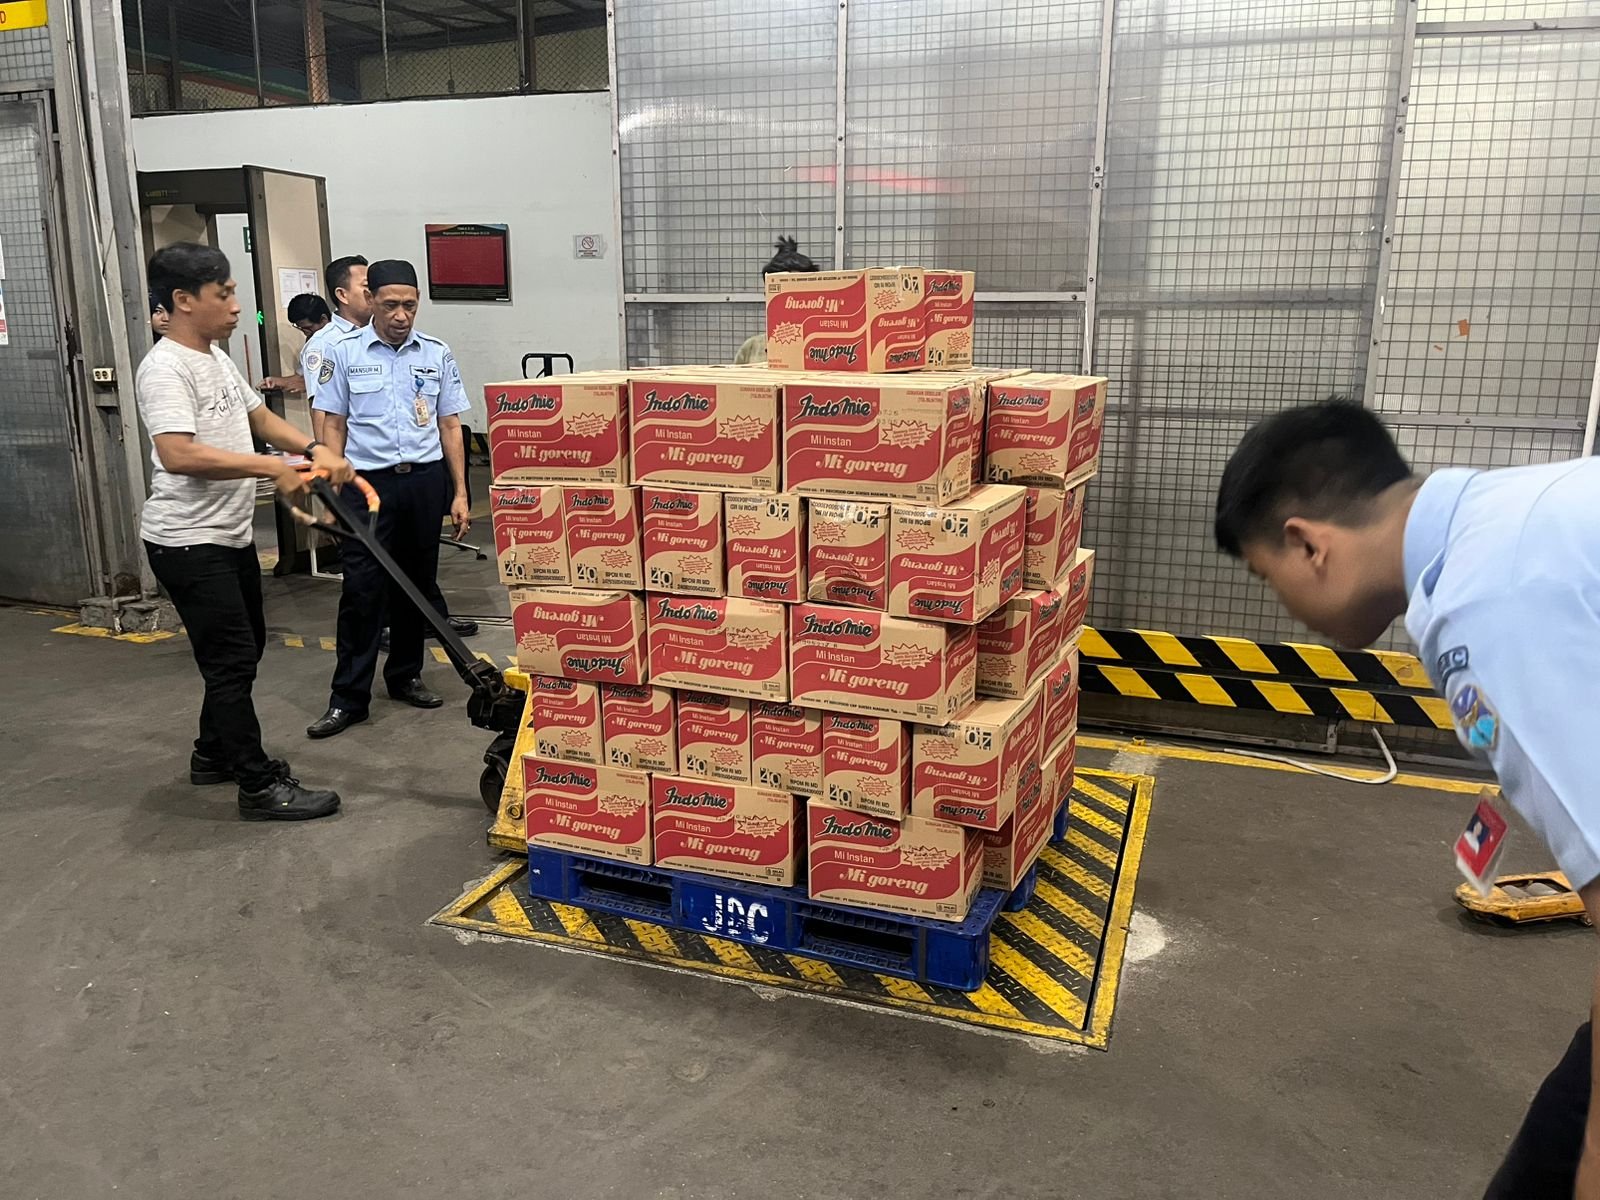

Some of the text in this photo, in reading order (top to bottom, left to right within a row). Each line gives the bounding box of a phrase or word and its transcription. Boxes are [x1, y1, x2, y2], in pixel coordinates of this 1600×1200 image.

[785, 296, 844, 312] Mi goreng
[507, 429, 542, 438] Mi Instan
[655, 429, 692, 439] Mi Instan
[811, 435, 851, 446] Mi Instan
[995, 429, 1056, 445] Mi goreng
[514, 445, 592, 464] Mi goreng
[661, 447, 744, 468] Mi goreng
[816, 454, 908, 478] Mi goreng
[503, 528, 554, 539] Mi goreng
[576, 530, 626, 542] Mi goreng
[652, 532, 708, 547] Mi goreng
[732, 543, 786, 558] Mi goreng
[816, 549, 874, 566] Mi goreng
[900, 558, 965, 576] Mi goreng
[533, 606, 604, 627] Mi goreng
[601, 635, 611, 643] Mi
[669, 633, 704, 646] Mi Instan
[674, 651, 754, 676] Mi goreng
[816, 650, 855, 663] Mi Instan
[821, 668, 910, 695] Mi goreng
[539, 709, 587, 724] Mi goreng
[612, 717, 662, 732] Mi goreng
[687, 724, 739, 742] Mi goreng
[760, 736, 815, 753] Mi goreng
[832, 751, 888, 771] Mi goreng
[925, 766, 987, 785] Mi goreng
[555, 798, 577, 810] Instan
[550, 814, 621, 840] Mi goreng
[675, 820, 711, 833] Mi Instan
[680, 836, 760, 861] Mi goreng
[834, 850, 875, 864] Mi Instan
[839, 868, 928, 895] Mi goreng
[702, 894, 768, 943] JDC
